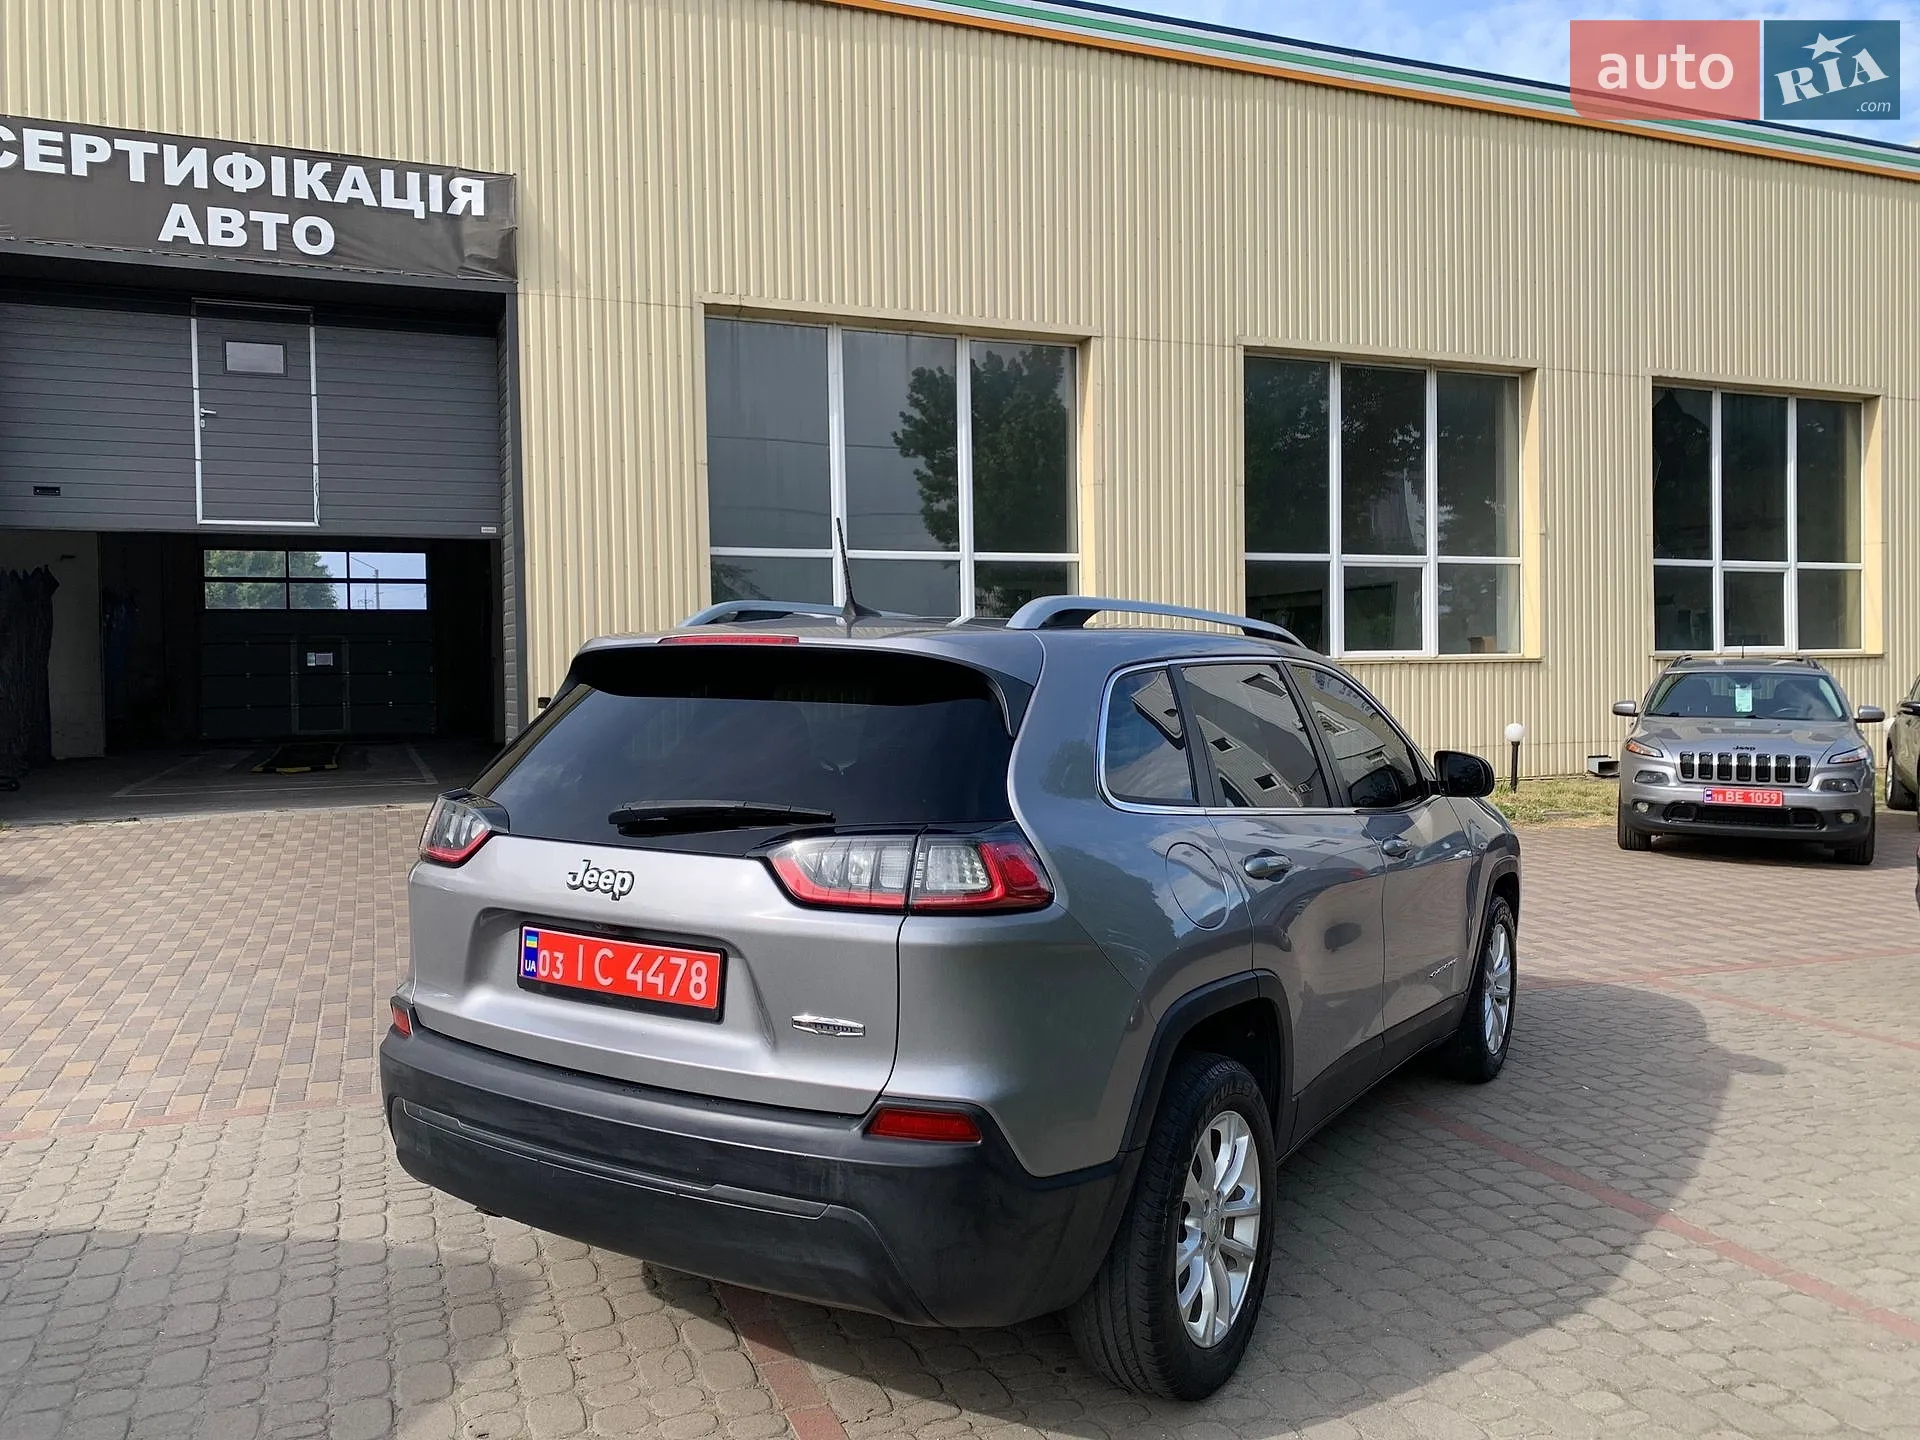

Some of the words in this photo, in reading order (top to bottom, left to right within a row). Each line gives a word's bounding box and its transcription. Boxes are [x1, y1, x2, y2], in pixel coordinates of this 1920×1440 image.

[157, 202, 335, 256] АВТО
[1748, 792, 1778, 804] 1059
[566, 860, 635, 901] Jeep
[525, 960, 537, 973] UA
[538, 949, 566, 981] 03
[577, 944, 615, 987] IC
[625, 952, 708, 1001] 4478
